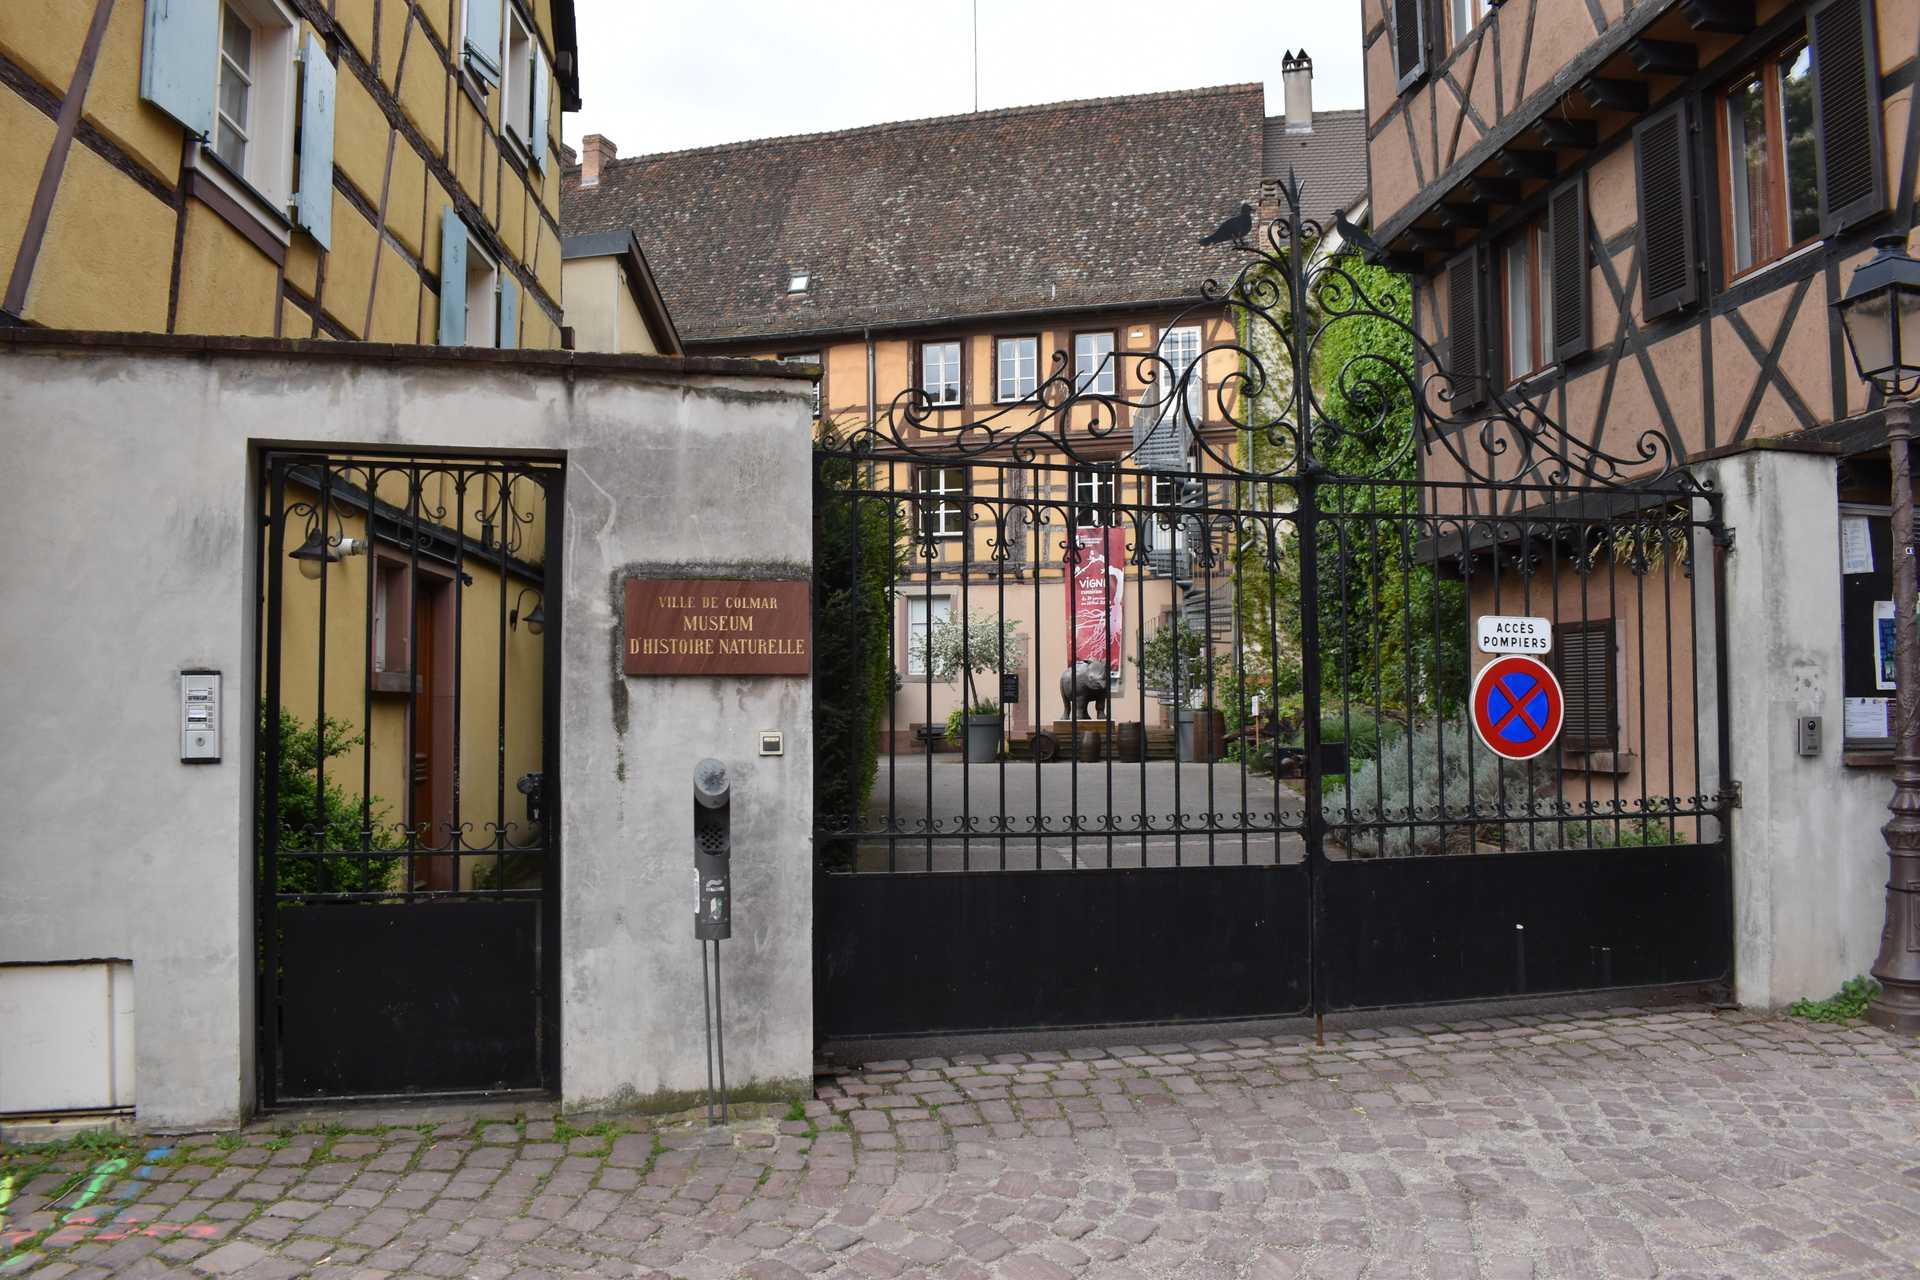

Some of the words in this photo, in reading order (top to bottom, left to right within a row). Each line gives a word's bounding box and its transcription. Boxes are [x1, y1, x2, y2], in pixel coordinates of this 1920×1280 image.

[1079, 577, 1106, 588] ViGN
[658, 596, 696, 609] VILLE
[702, 597, 719, 609] DE
[725, 597, 778, 609] COLMAR
[683, 615, 754, 632] MUSEUM
[1496, 621, 1534, 634] ACCÈS
[630, 637, 714, 655] D'HISTOIRE
[719, 638, 805, 655] NATURELLE
[1483, 636, 1547, 649] POMPIERS
